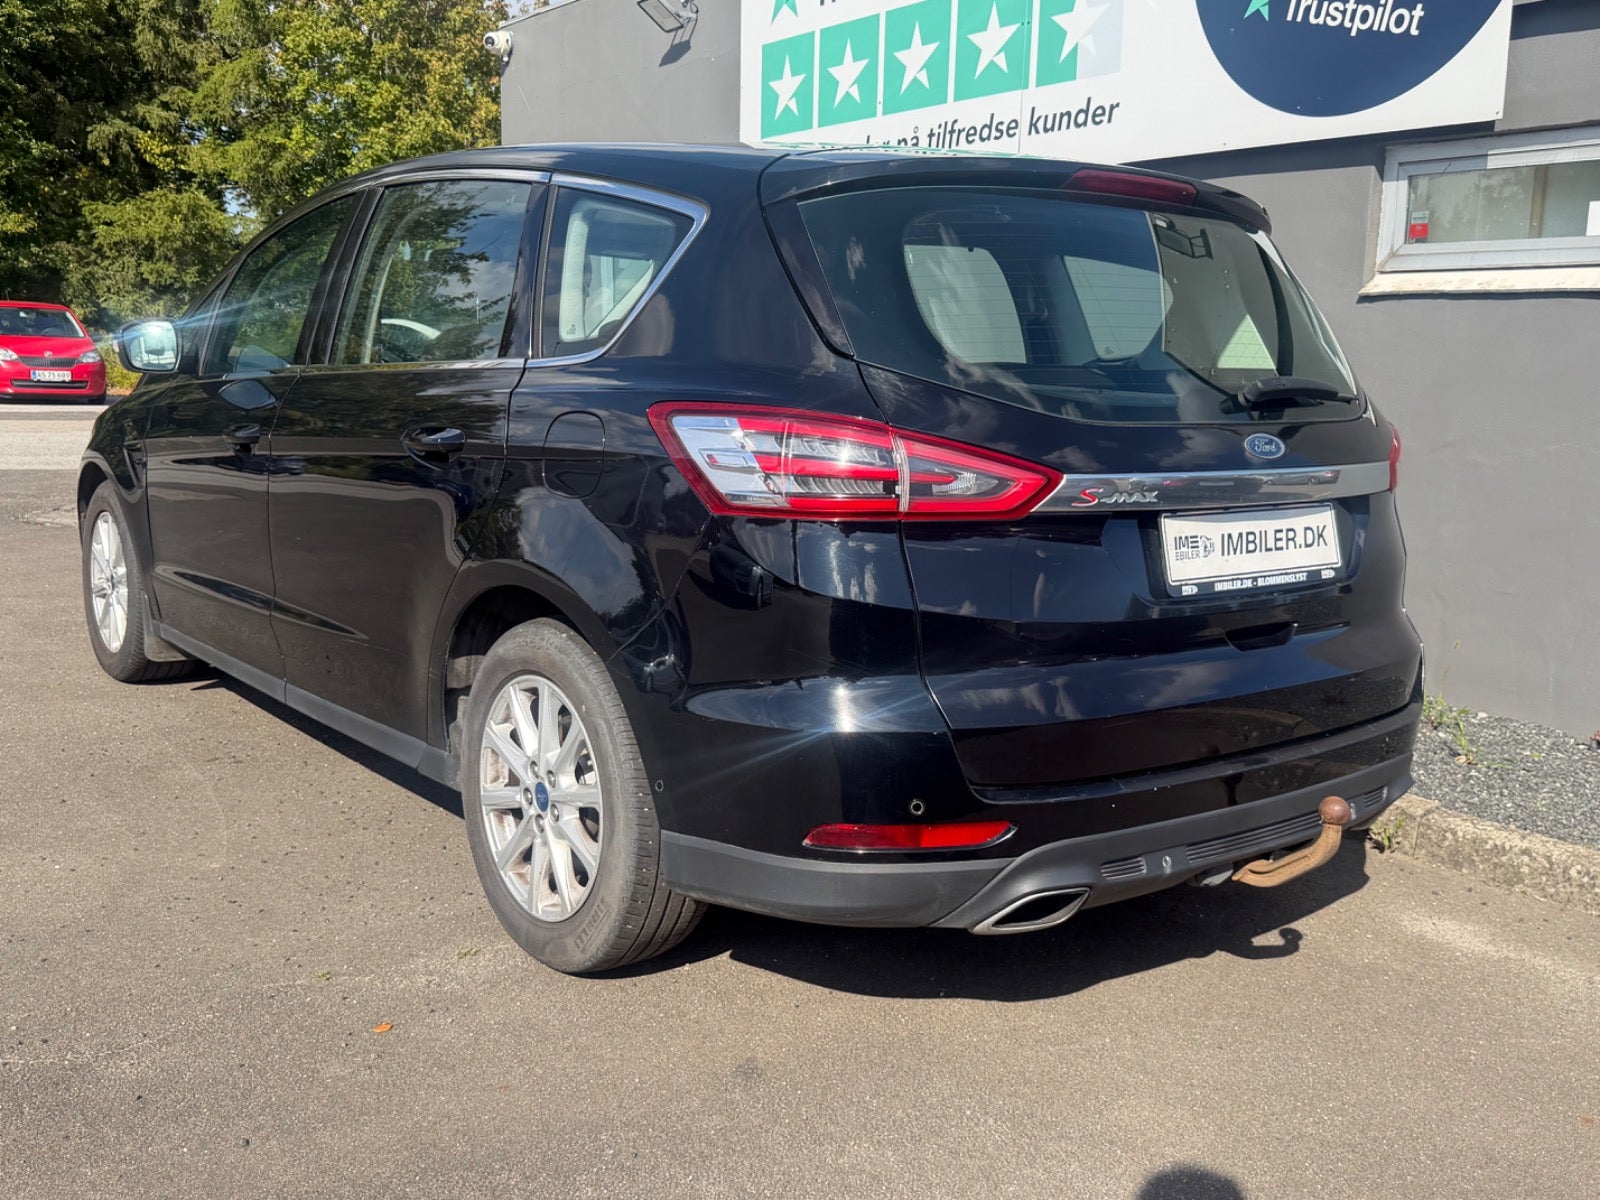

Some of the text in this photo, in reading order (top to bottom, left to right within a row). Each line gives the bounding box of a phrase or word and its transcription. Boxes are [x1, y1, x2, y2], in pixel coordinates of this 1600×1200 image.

[1286, 0, 1424, 36] Trustpilot
[927, 113, 1019, 149] tilfredse
[1027, 97, 1120, 136] kunder
[1254, 438, 1277, 453] Ford
[1221, 525, 1328, 556] IMBILER.DK
